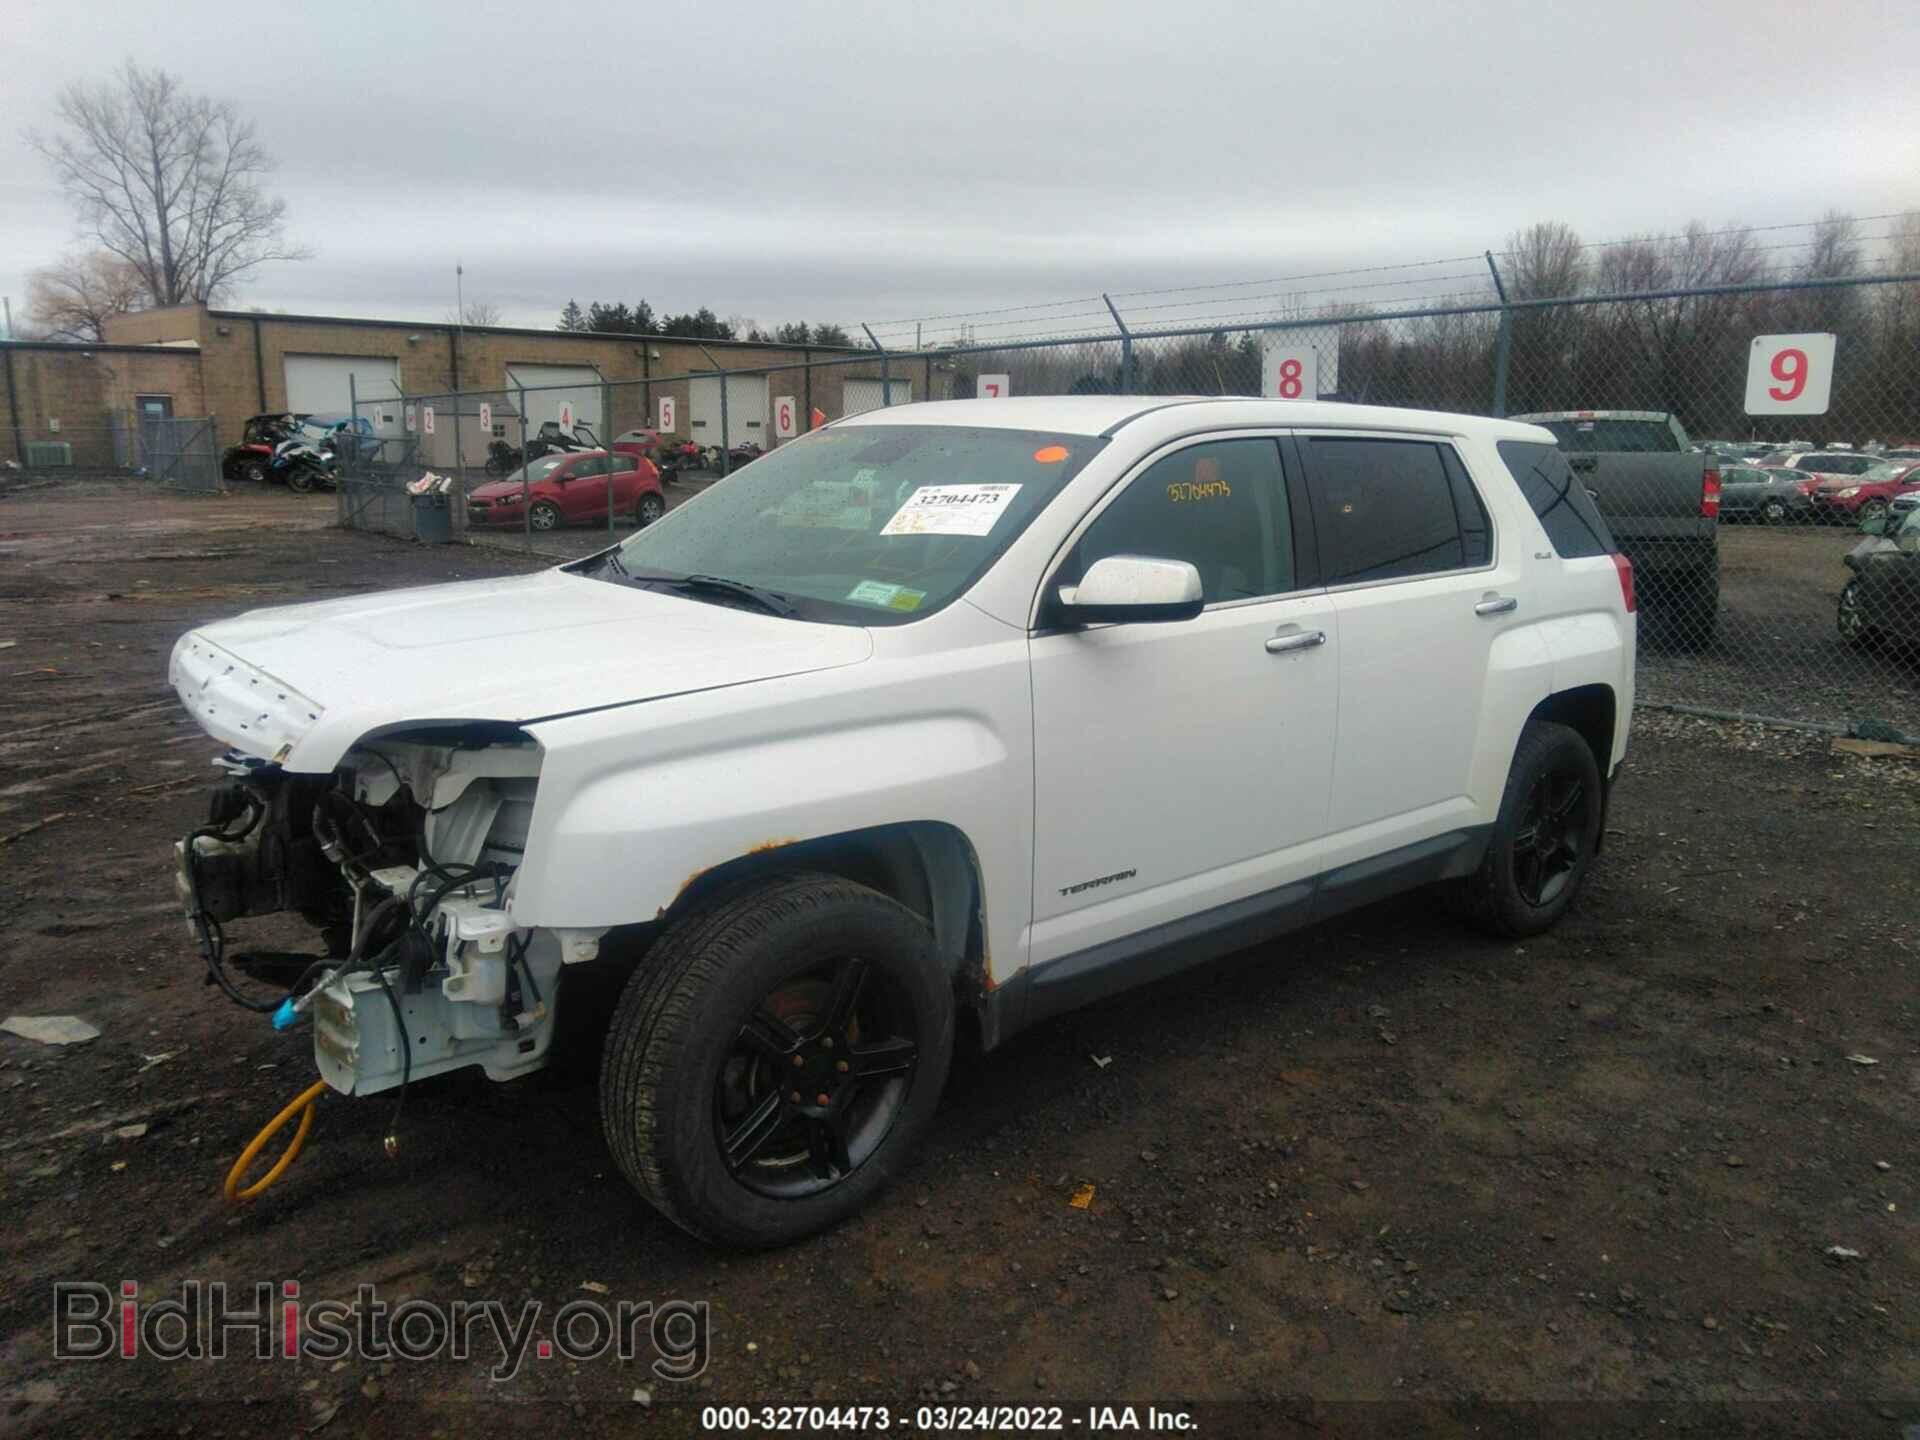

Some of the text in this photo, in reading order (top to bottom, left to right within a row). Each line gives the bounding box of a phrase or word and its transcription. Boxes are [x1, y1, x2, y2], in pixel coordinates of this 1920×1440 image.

[1279, 359, 1302, 399] 8
[1769, 349, 1808, 401] 9
[425, 411, 432, 429] 2
[482, 408, 488, 427] 3
[562, 408, 569, 426] 4
[663, 404, 671, 426] 5
[780, 404, 790, 431] 6
[914, 493, 1000, 506] 32704473
[1058, 868, 1136, 896] TERRAIN
